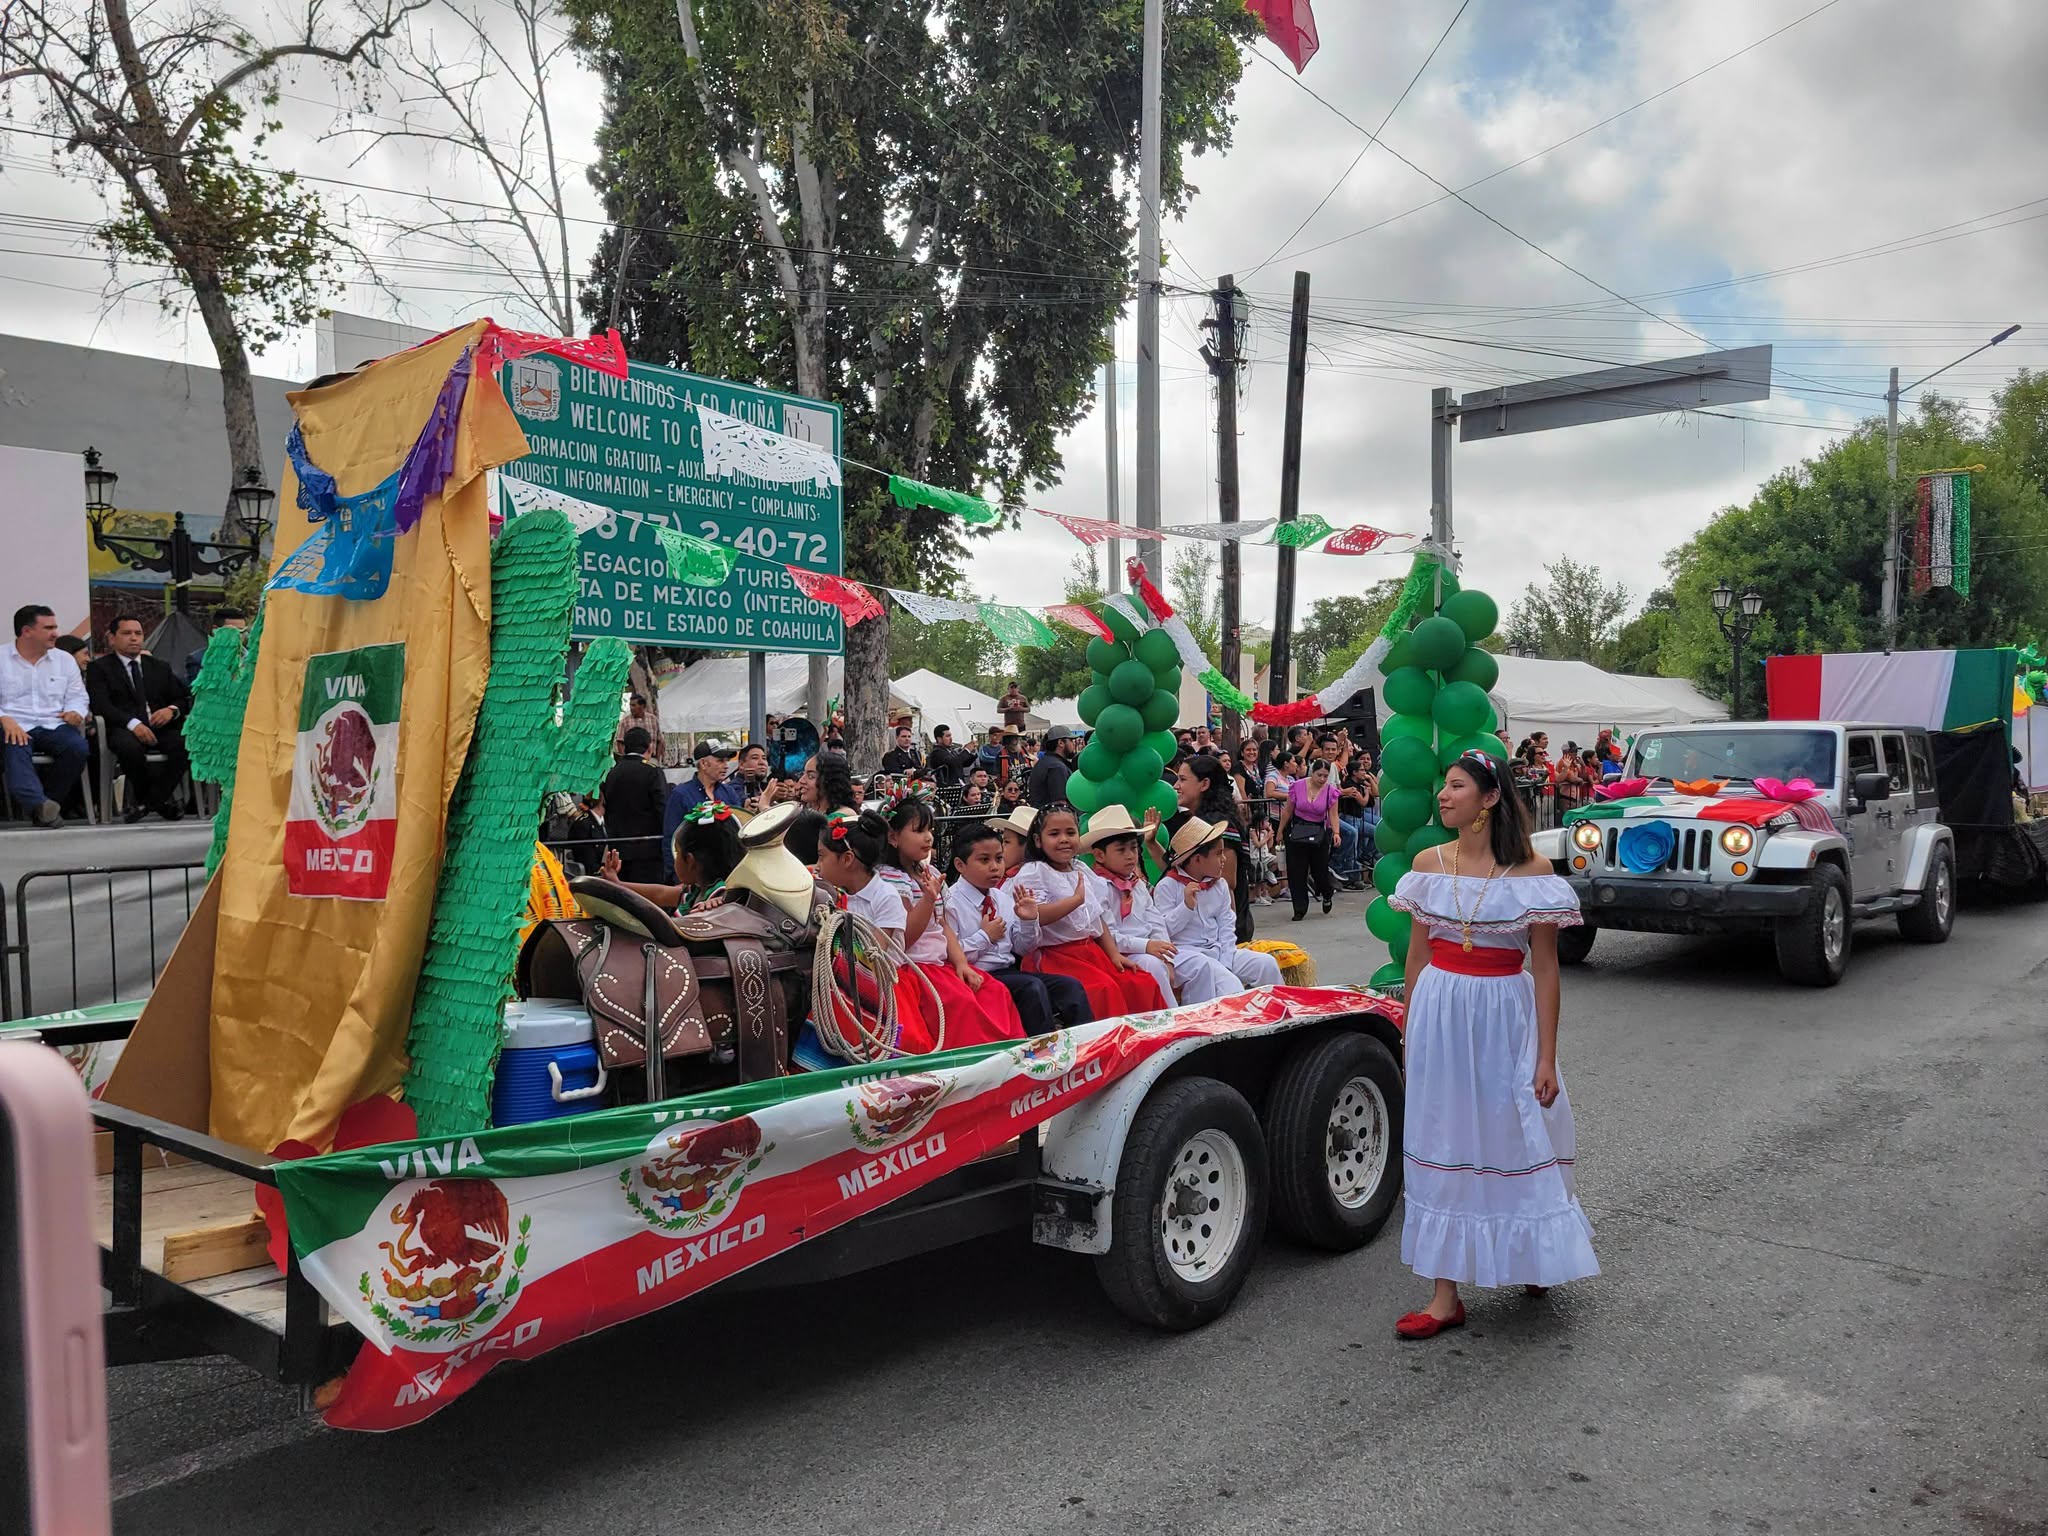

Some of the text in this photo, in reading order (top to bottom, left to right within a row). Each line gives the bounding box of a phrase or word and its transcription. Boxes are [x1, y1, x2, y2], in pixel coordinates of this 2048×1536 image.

[570, 366, 676, 410] BIENVENIDOS
[683, 389, 694, 414] A
[729, 398, 776, 430] ACUÑA
[570, 402, 699, 449] WELCOME TO C
[523, 434, 597, 464] ORMACION
[605, 447, 663, 474] GRATUITA
[509, 460, 559, 486] TOURIST
[565, 468, 649, 499] INFORMATION
[668, 484, 734, 510] EMERGENCY
[700, 520, 828, 564] 2-40-72
[615, 581, 644, 602] DE
[653, 585, 732, 609] MEXICO
[743, 590, 838, 621] (INTERIOR)
[735, 567, 797, 590] TURIS
[624, 610, 657, 631] DEL
[667, 613, 728, 634] ESTADO
[735, 618, 755, 637] DE
[762, 620, 835, 642] COAHUILA
[325, 674, 366, 700] VIVA
[1010, 1057, 1103, 1118] MEXICO
[378, 1137, 485, 1179] VIVA
[837, 1132, 947, 1200] MEXICO
[636, 1214, 765, 1294] MEXICO
[394, 1317, 543, 1407] MEXICO
